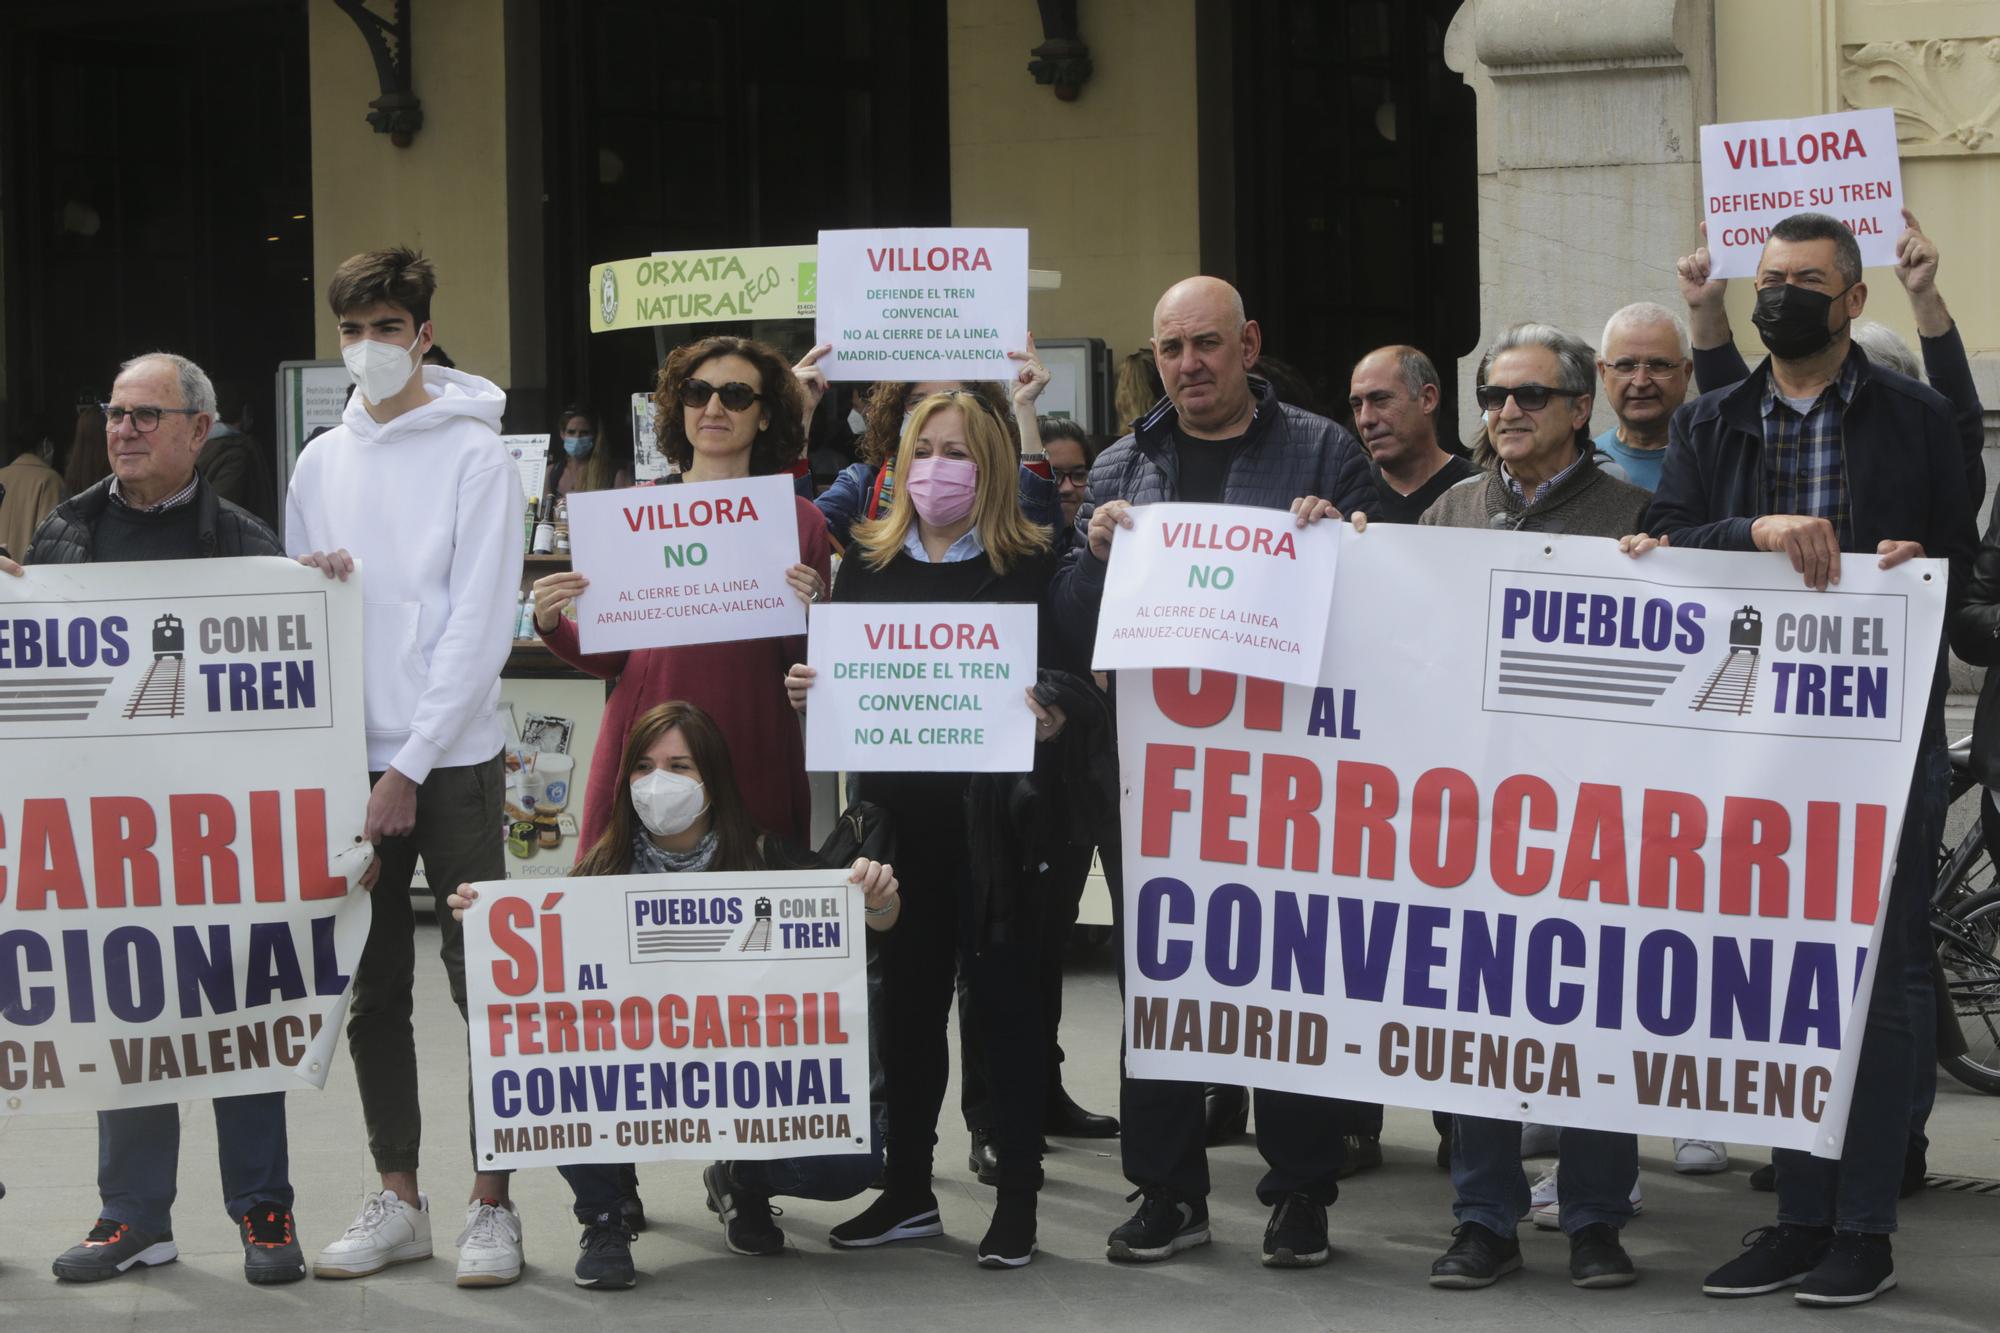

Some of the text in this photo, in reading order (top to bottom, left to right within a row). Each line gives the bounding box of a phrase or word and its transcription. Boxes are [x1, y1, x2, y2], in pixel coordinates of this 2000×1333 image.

[1723, 128, 1867, 170] VILLORA
[1710, 180, 1892, 214] DEFIENDE SU TREN
[637, 256, 746, 286] ORXATA
[867, 247, 992, 272] VILLORA
[744, 266, 780, 303] ECO
[867, 288, 975, 299] DEFIENDE EL TREN
[637, 291, 752, 320] NATURAL
[882, 308, 959, 318] CONVENCIAL
[843, 328, 999, 340] NO AL CIERRE DE LA LINEA
[837, 349, 1004, 361] MADRID-CUENCA-VALENCIA
[623, 496, 759, 532] VILLORA
[664, 542, 708, 568] NO
[1161, 522, 1297, 560] VILLORA
[619, 579, 759, 602] AL CIERRE DE LA LINEA
[1188, 565, 1234, 590] NO
[597, 597, 785, 624] ARANJUEZ-CUENCA-VALENCIA
[1136, 606, 1279, 629] AL CIERRE DE LA LINEA
[1501, 587, 1706, 655] PUEBLOS
[200, 614, 313, 655] CON EL
[864, 623, 999, 650] VILLORA
[1112, 626, 1301, 654] ARANJUEZ-CUENCA-VALENCIA
[1775, 612, 1888, 657] CON EL
[833, 662, 1010, 679] DEFIENDE EL TREN
[200, 660, 316, 713] TREN
[1772, 661, 1889, 719] TREN
[859, 694, 982, 711] CONVENCIAL
[1307, 686, 1361, 740] AL
[854, 728, 984, 745] NO AL CIERRE
[634, 897, 743, 927] PUEBLOS
[779, 898, 840, 919] CON EL
[779, 922, 840, 949] TREN
[578, 963, 608, 991] AL
[1136, 876, 1868, 1050] CONVENCIONA
[488, 991, 849, 1057] FERROCARRIL
[1132, 996, 1328, 1066] MADRID
[1378, 1020, 1581, 1098] CUENCA
[492, 1058, 850, 1118] CONVENCIONAL
[493, 1122, 592, 1153] MADRID
[616, 1118, 711, 1147] CUENCA
[735, 1114, 851, 1144] VALENCIA
